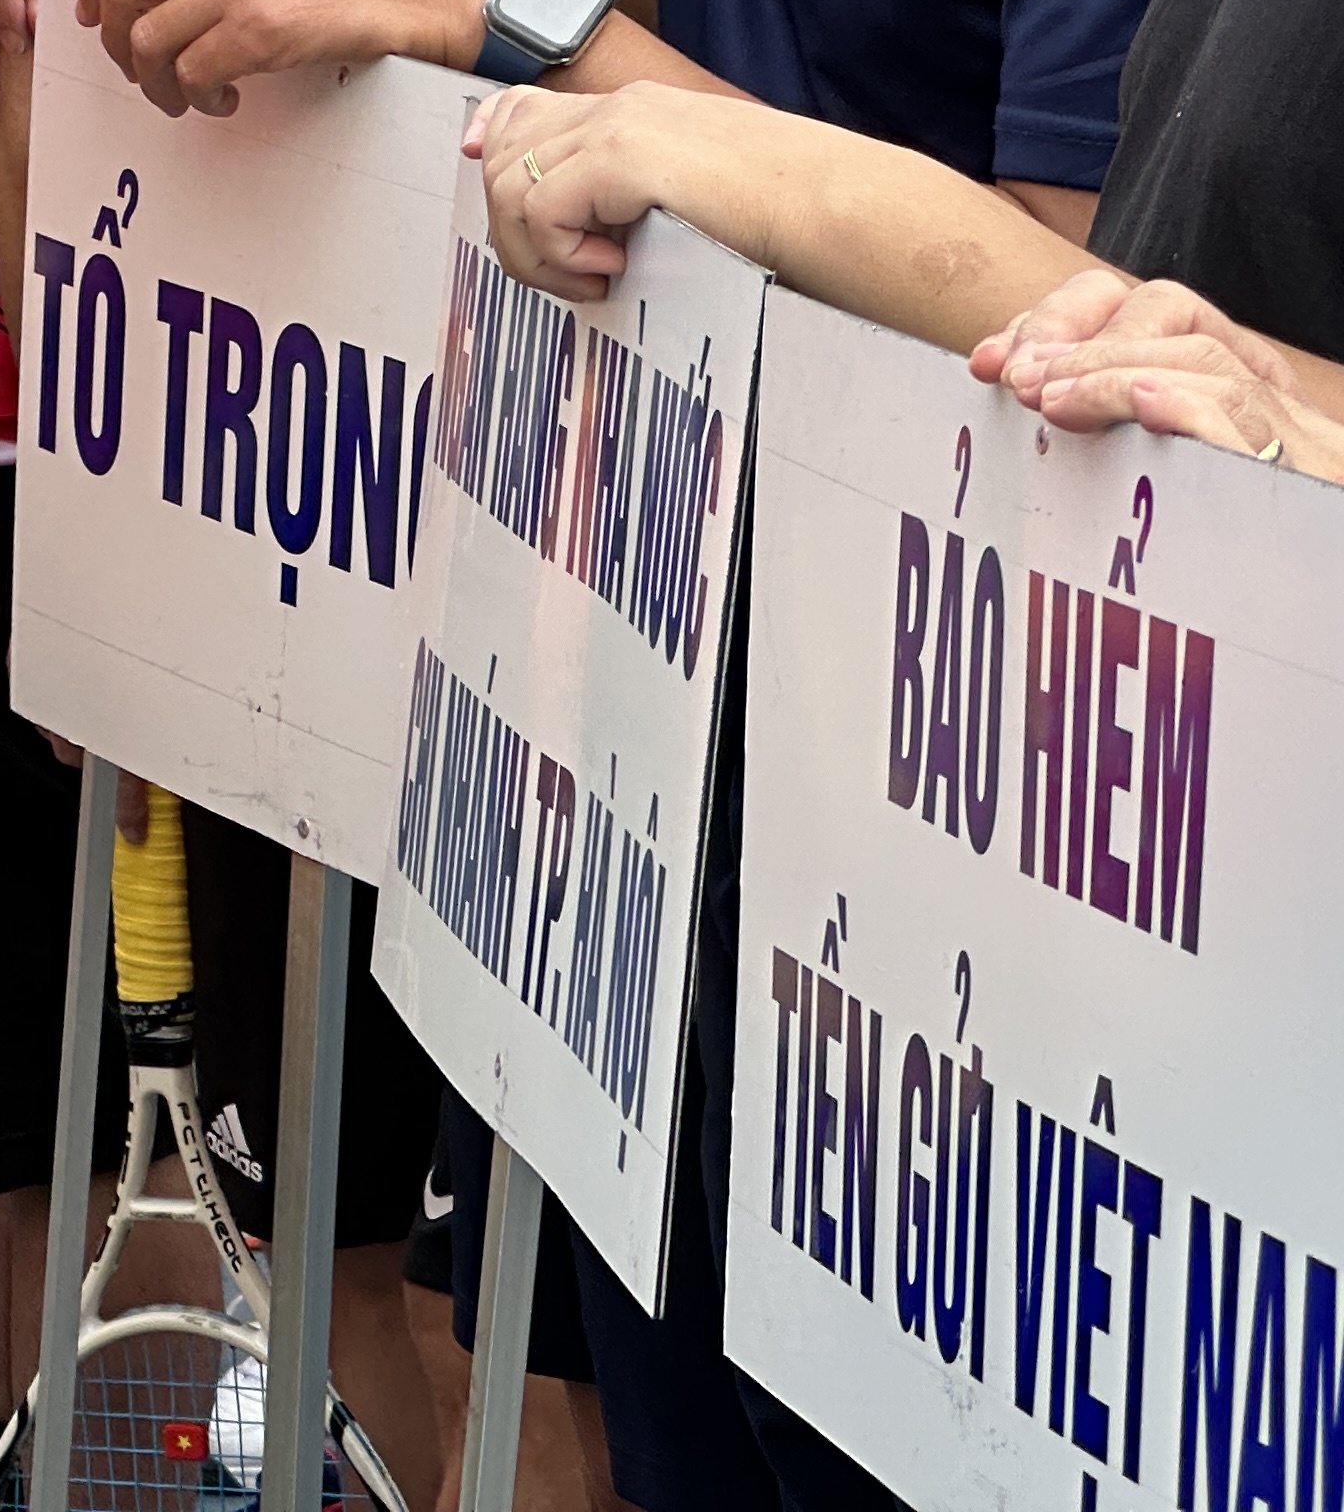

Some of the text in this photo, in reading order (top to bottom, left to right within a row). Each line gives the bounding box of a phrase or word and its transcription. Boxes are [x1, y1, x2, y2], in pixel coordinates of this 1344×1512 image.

[34, 168, 140, 476] TỔ
[566, 299, 647, 615] NHÀ
[628, 334, 723, 682] NƯỚC
[398, 636, 446, 896] CHI
[429, 652, 531, 989] NHÁNH
[563, 752, 617, 1076] HÀ
[601, 791, 667, 1174] NỘI
[887, 424, 1216, 956] BẢO HIỂM
[204, 1129, 264, 1184] adidas
[771, 891, 884, 1304] TIỀN
[894, 949, 997, 1385] GỬI
[1014, 1073, 1164, 1512] VIỆT
